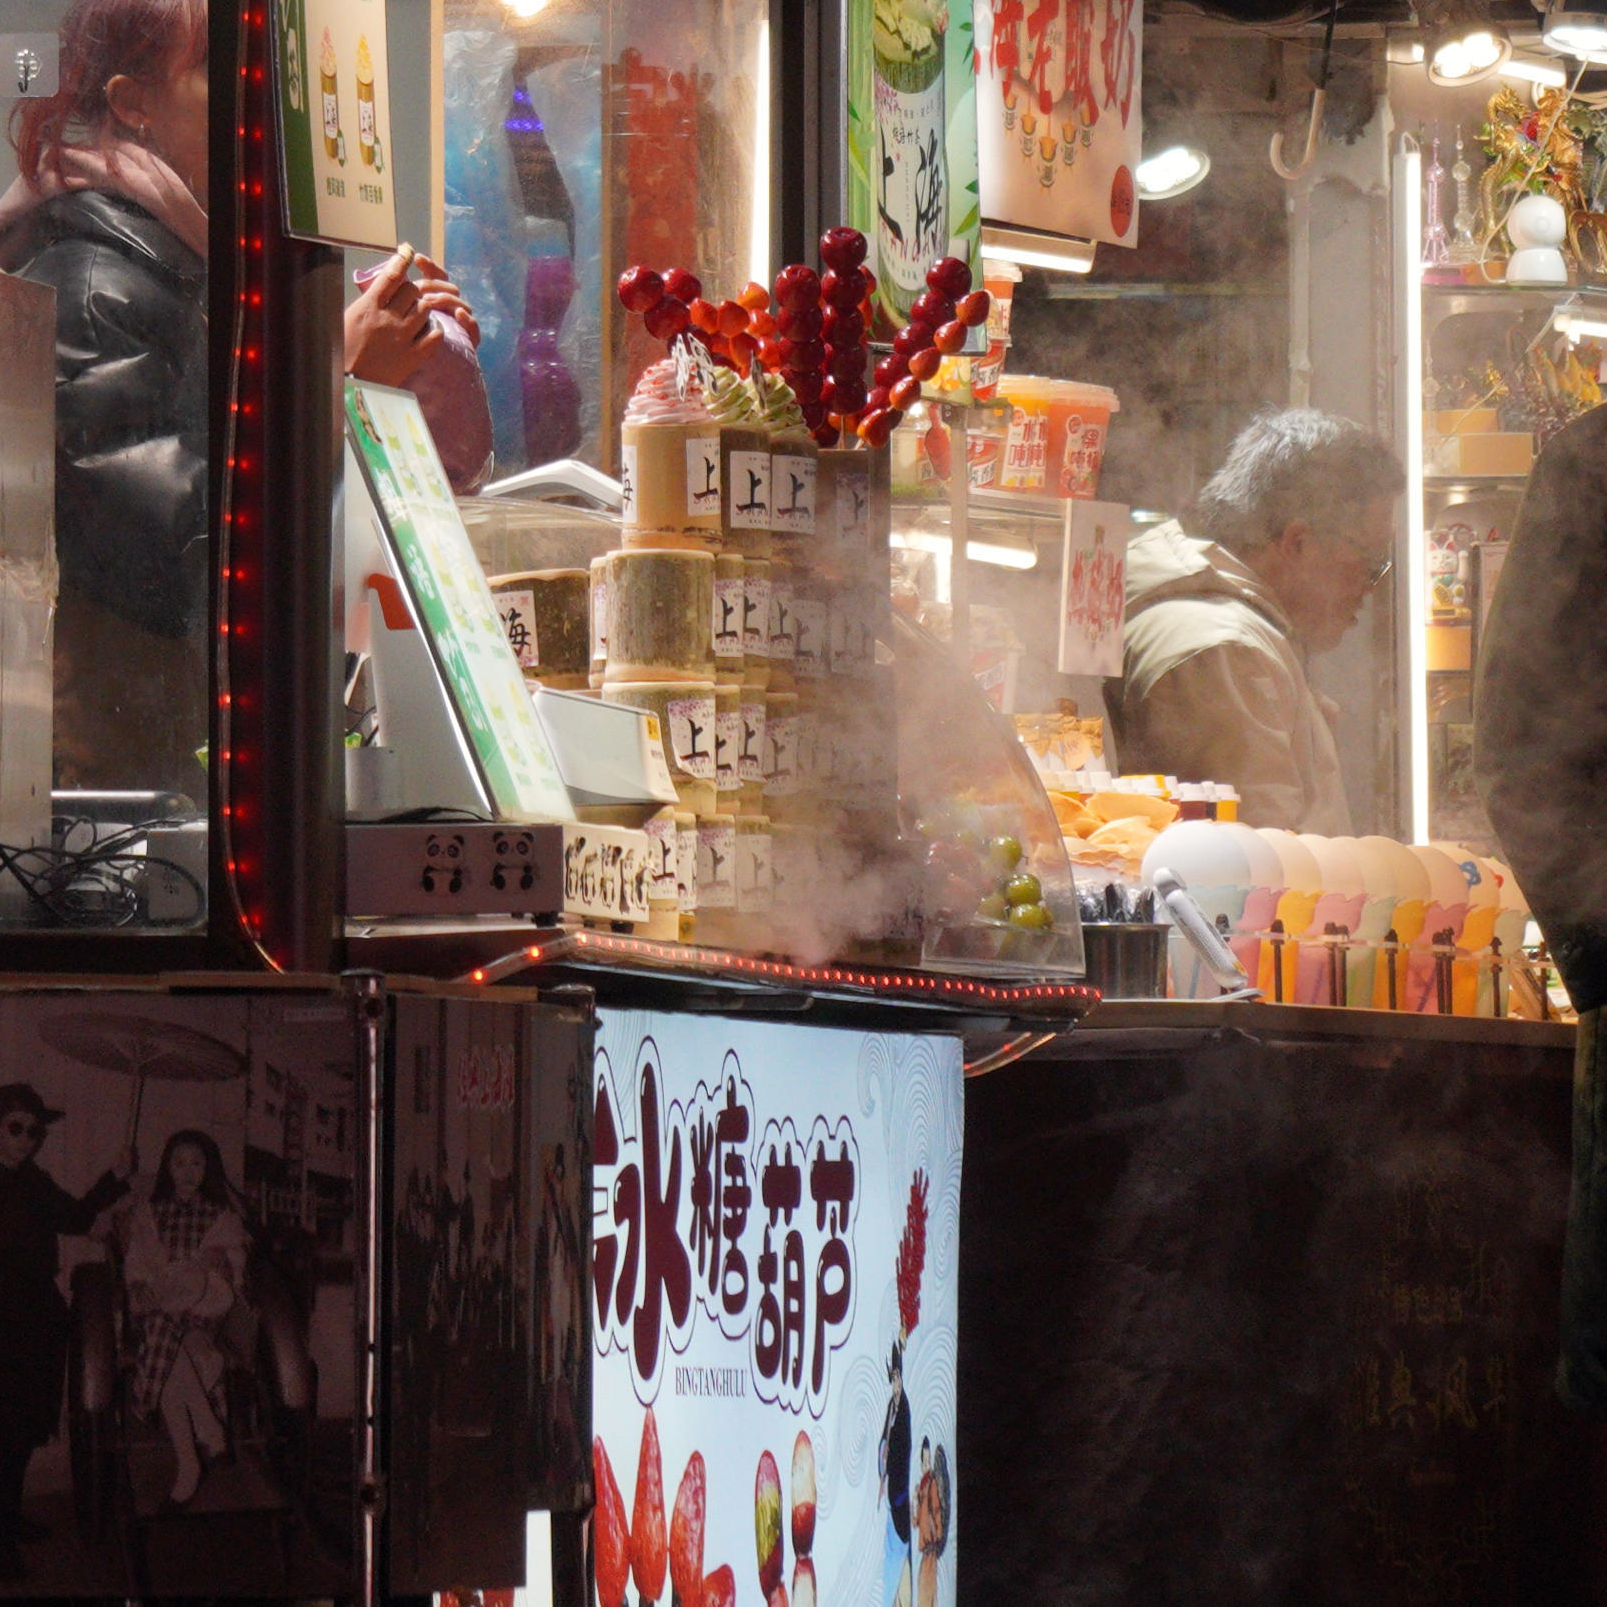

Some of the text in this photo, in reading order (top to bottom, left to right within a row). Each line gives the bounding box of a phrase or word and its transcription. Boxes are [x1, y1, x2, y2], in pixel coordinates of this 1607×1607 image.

[735, 468, 767, 511] 上
[679, 718, 710, 760] 上
[674, 1365, 748, 1399] BINGTANGHULU
